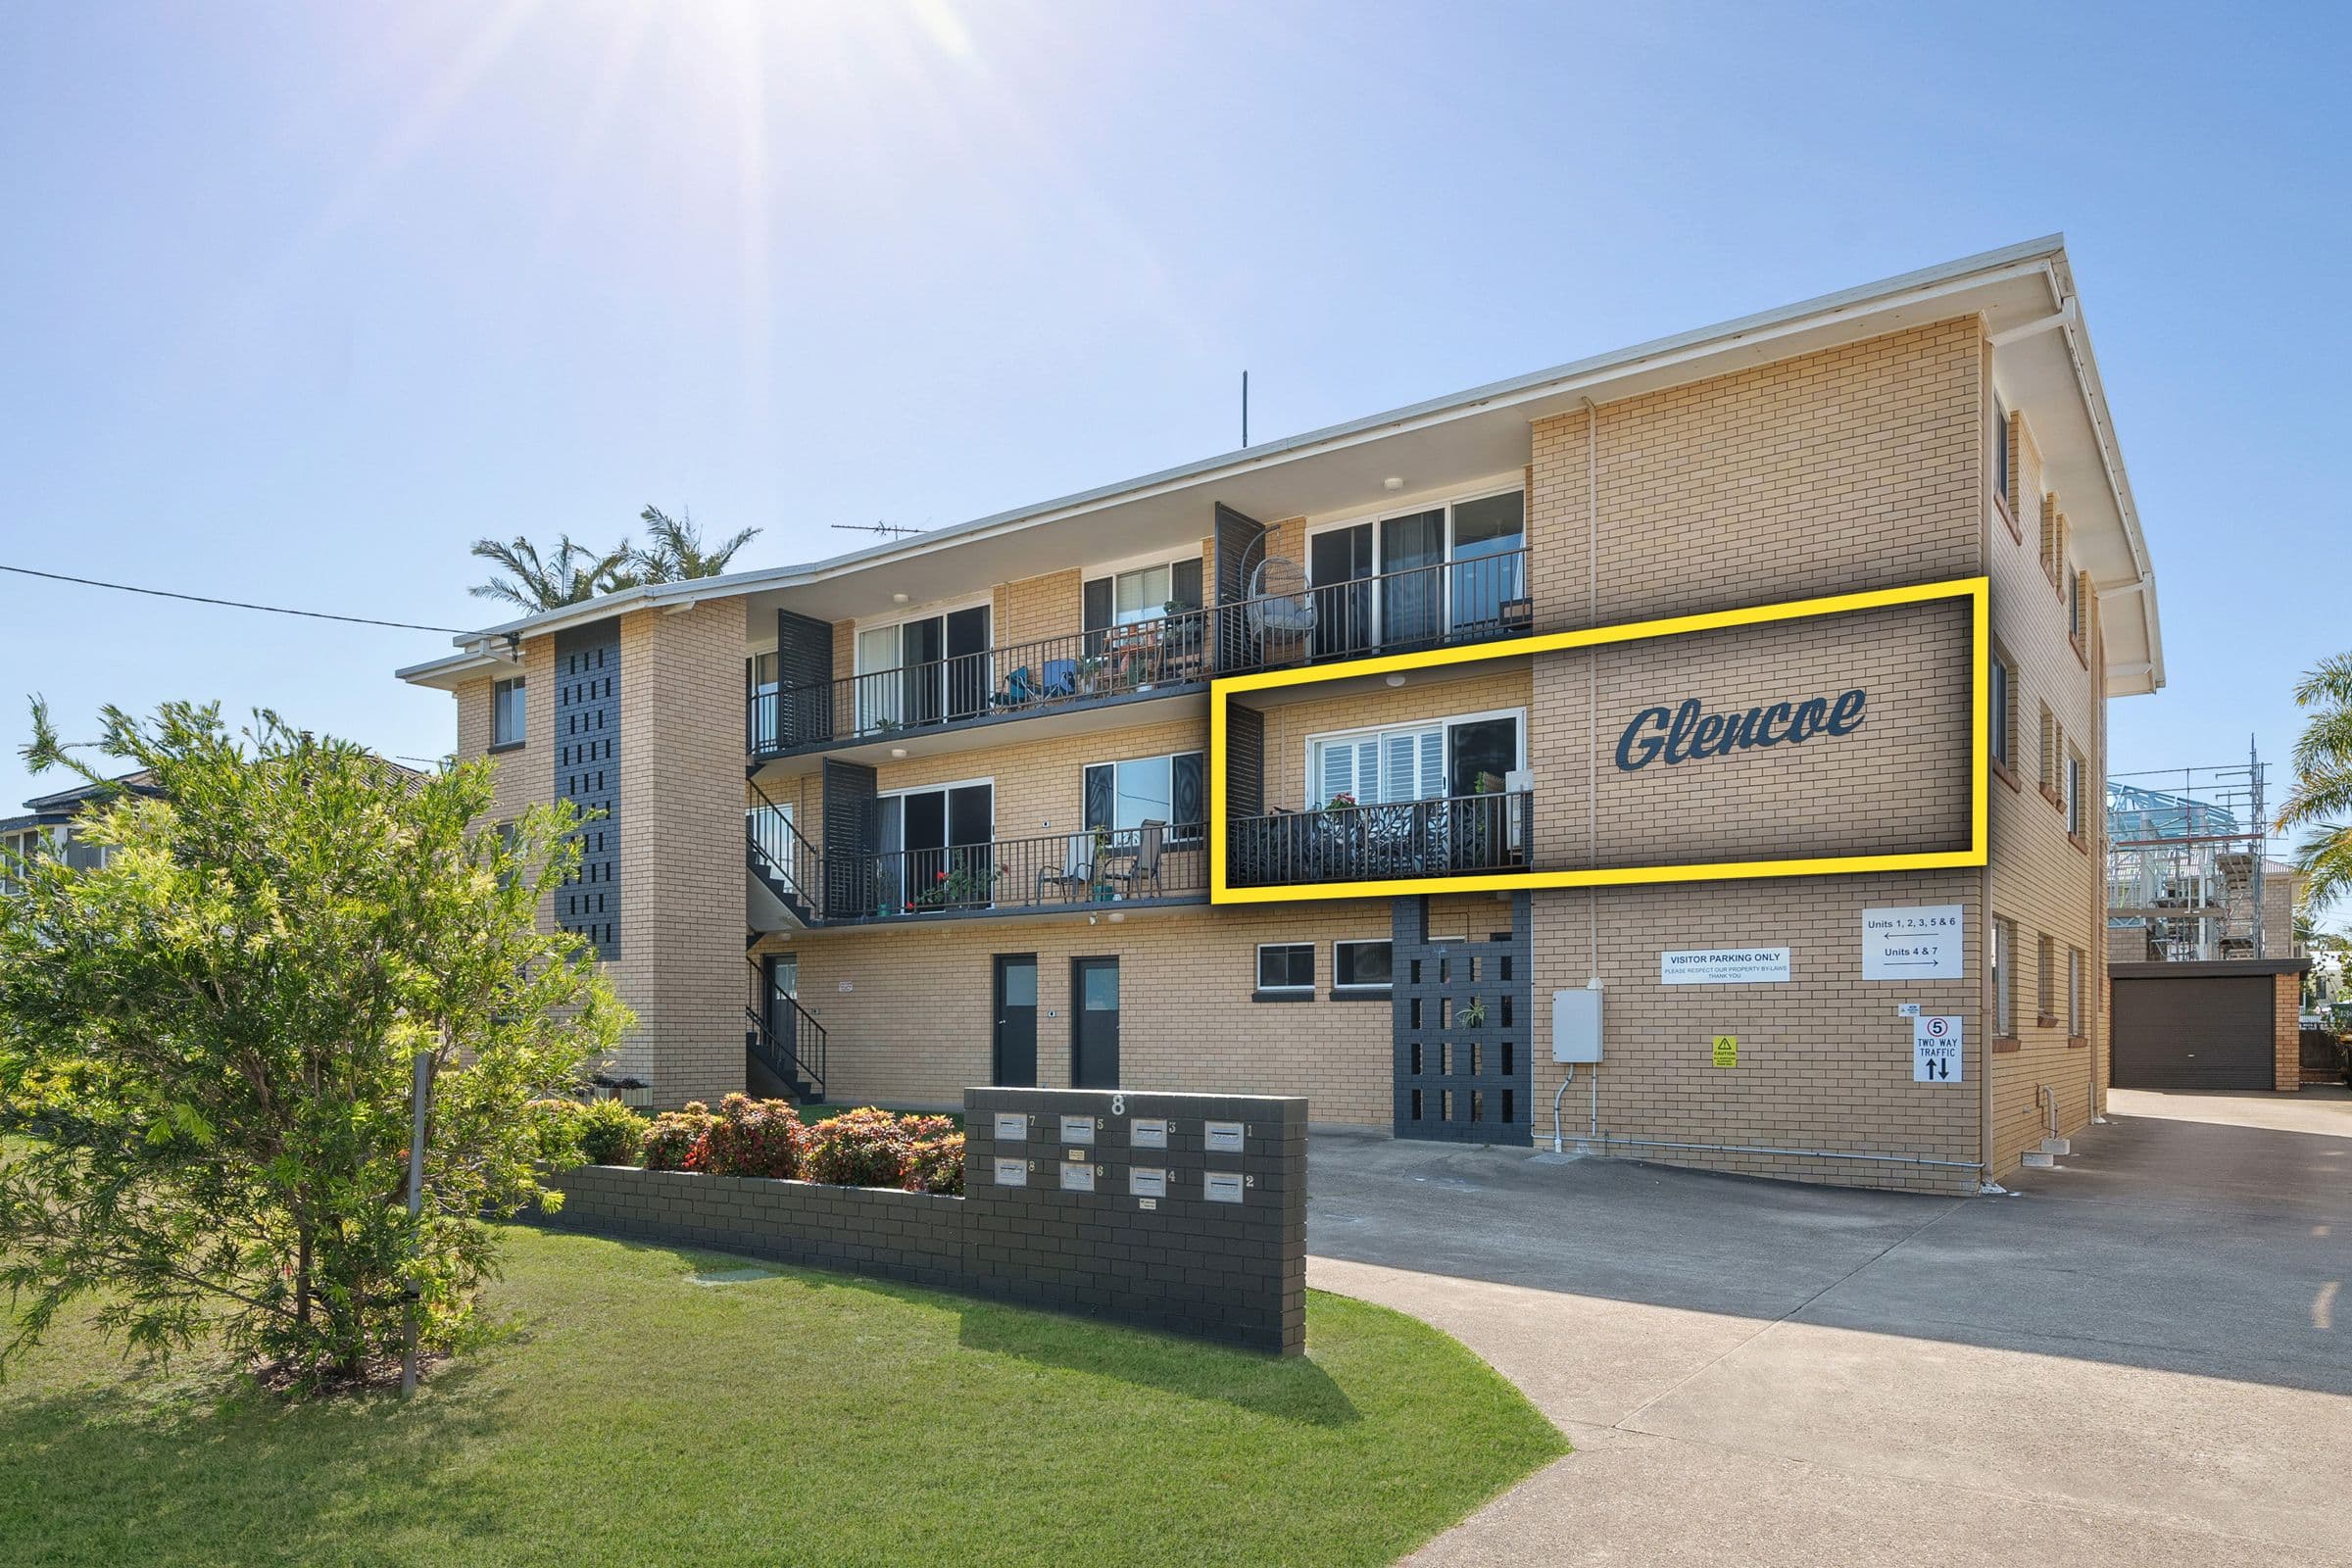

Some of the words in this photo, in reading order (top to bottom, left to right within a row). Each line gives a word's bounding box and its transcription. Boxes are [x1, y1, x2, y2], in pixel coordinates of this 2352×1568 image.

[1615, 689, 1866, 771] Glencoe
[1868, 920, 1893, 929] Units
[1896, 919, 1904, 928] 1,
[1907, 919, 1916, 928] 2,
[1919, 918, 1928, 927] 3,
[1939, 917, 1946, 926] &
[1949, 917, 1956, 926] 6
[1885, 948, 1910, 956] Units
[1671, 956, 1707, 964] VISITOR
[1709, 954, 1752, 963] PARKING
[1754, 953, 1781, 961] ONLY
[1933, 1021, 1942, 1034] 5
[1918, 1038, 1935, 1047] TWO
[1939, 1038, 1958, 1047] WAY
[1920, 1048, 1955, 1057] TRAFFIC
[1111, 1095, 1125, 1115] 8
[1028, 1115, 1035, 1126] 7
[1097, 1118, 1104, 1129] 5
[1168, 1121, 1176, 1133] 3
[1247, 1125, 1253, 1137] 1
[1028, 1160, 1035, 1172] 8
[1096, 1165, 1103, 1176] 6
[1167, 1171, 1176, 1182] 4
[1246, 1175, 1254, 1187] 2
